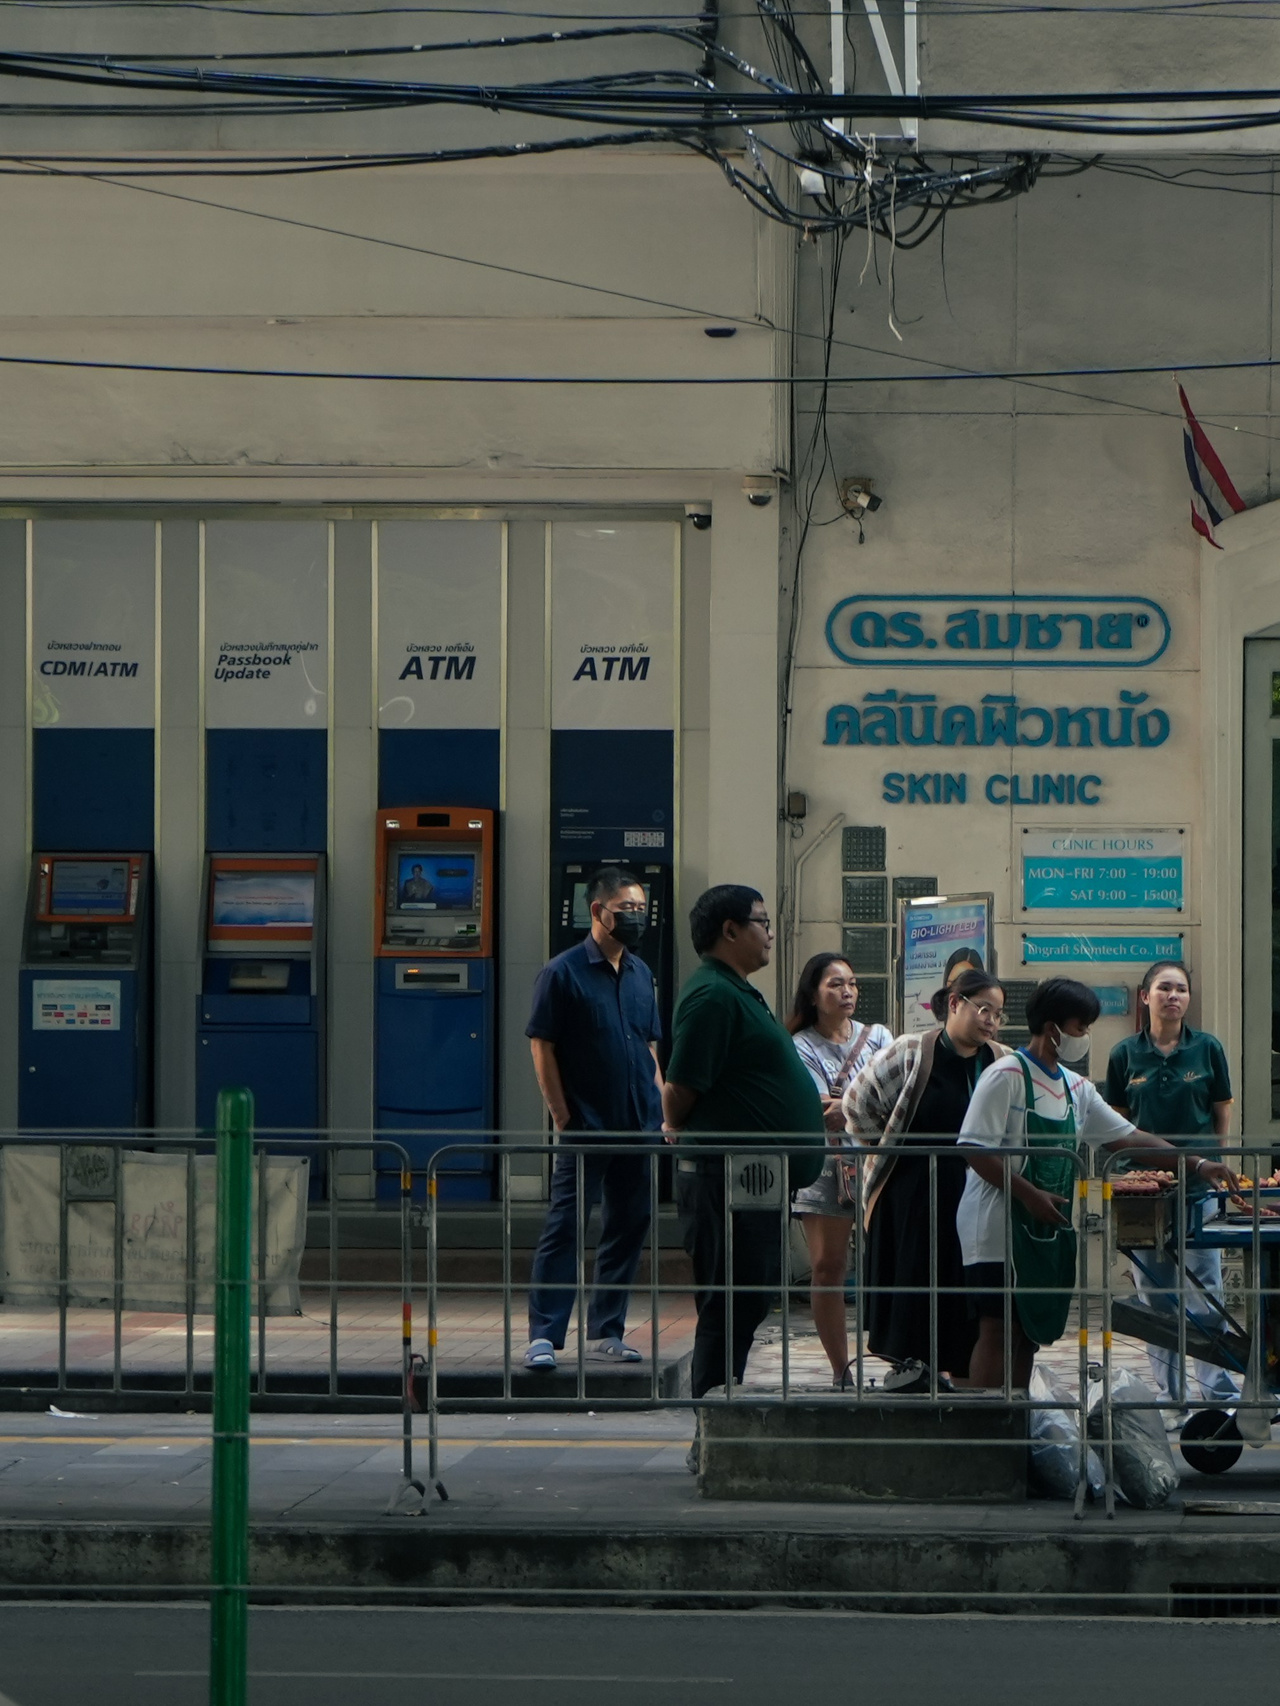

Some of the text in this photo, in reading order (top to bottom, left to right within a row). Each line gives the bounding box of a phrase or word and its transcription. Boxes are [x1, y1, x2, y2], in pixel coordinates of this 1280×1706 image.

[217, 653, 292, 666] Passbook
[40, 660, 139, 677] CDM/ATM
[214, 667, 271, 682] Update
[398, 656, 477, 680] ATM
[572, 657, 651, 681] ATM
[882, 772, 1103, 805] SKIN CLINIC
[1052, 839, 1154, 851] CLINIC HOURS
[1099, 867, 1126, 879] 7:00
[1144, 867, 1177, 879] 19:00
[1070, 889, 1094, 901] SAT
[1098, 889, 1126, 901] 9:00
[1144, 889, 1177, 901] 15:00
[910, 923, 958, 939] BIO-LIGHT
